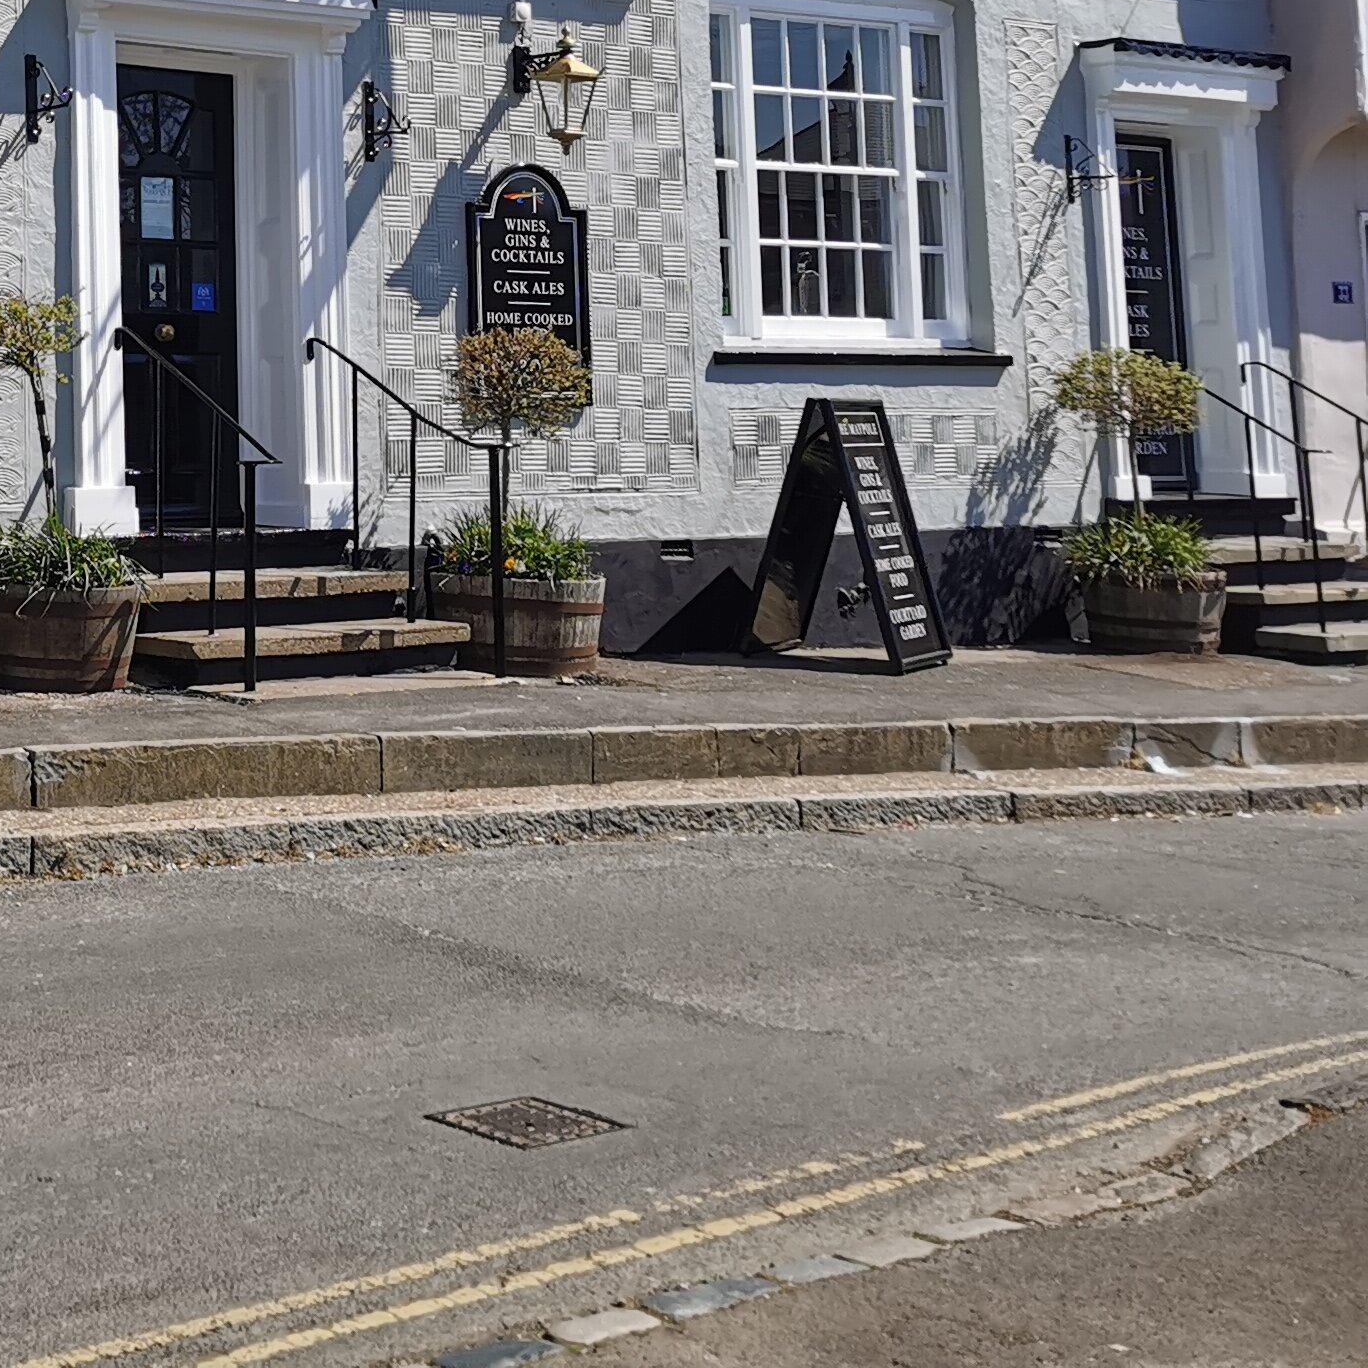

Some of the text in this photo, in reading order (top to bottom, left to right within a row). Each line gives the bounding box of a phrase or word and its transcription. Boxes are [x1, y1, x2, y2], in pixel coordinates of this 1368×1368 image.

[505, 218, 551, 234] WINES,
[505, 234, 550, 248] GINS &
[491, 249, 565, 264] COCKTAILS
[493, 281, 565, 295] CASK ALES
[1127, 304, 1150, 318] ASK
[487, 312, 573, 326] HOME COOKED
[1128, 324, 1150, 337] LES
[1135, 441, 1168, 455] RDEN
